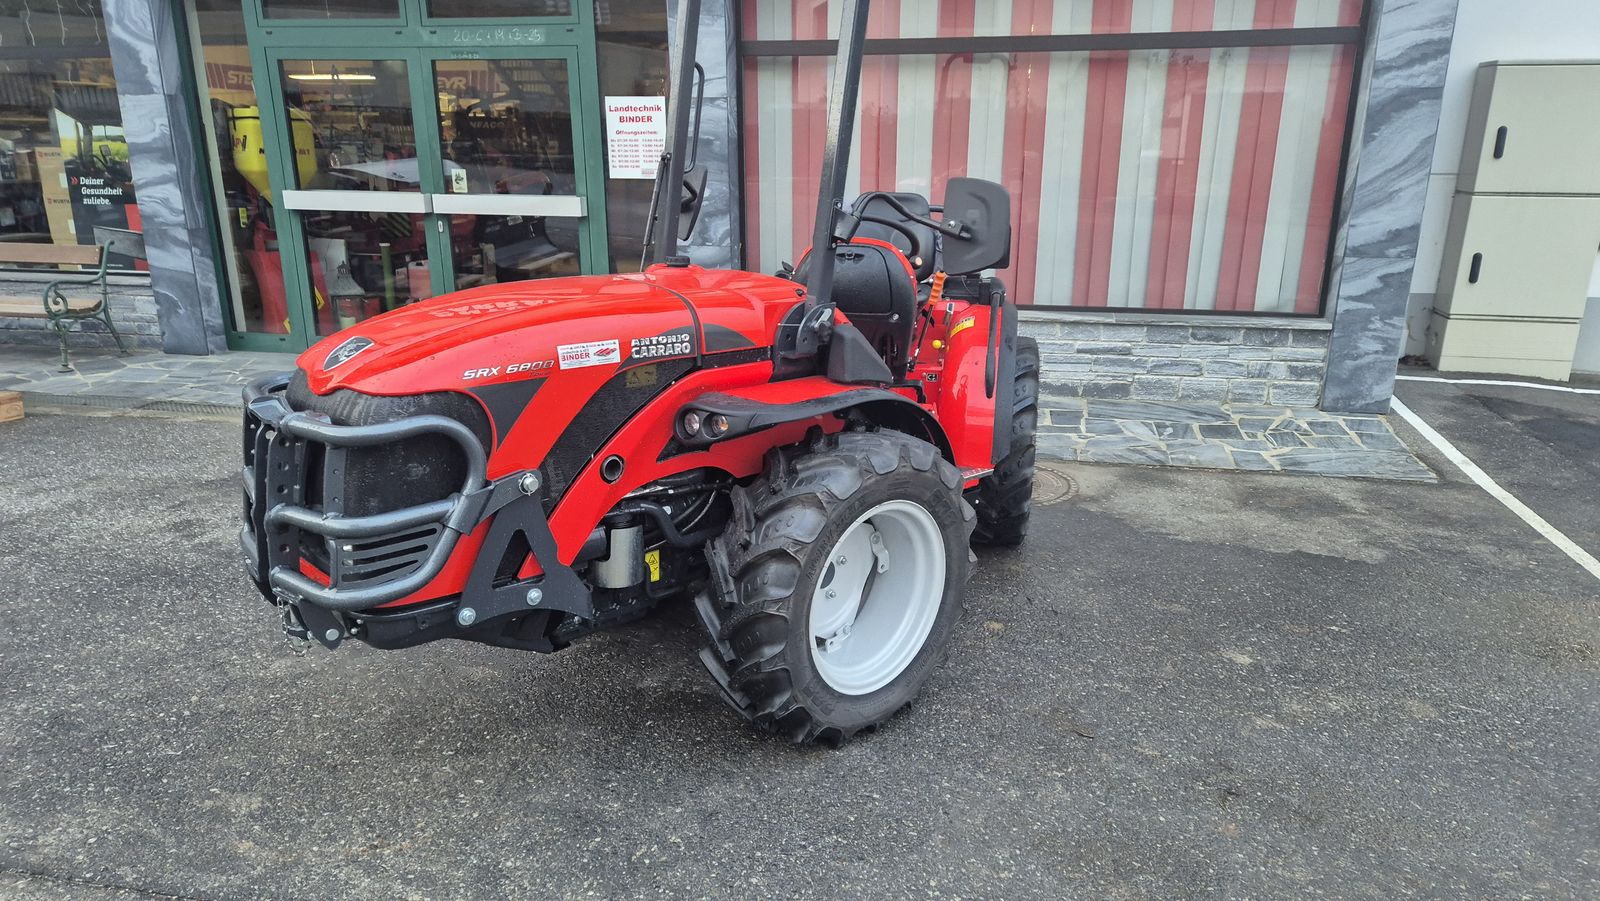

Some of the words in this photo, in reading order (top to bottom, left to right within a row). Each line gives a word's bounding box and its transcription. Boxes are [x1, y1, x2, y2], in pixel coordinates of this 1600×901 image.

[619, 115, 653, 123] BINDER
[79, 176, 104, 185] Deiner
[81, 187, 123, 196] Gesundheit
[83, 197, 112, 205] zuliebe.
[631, 333, 690, 346] ANTONIO
[631, 342, 691, 358] CARRARO
[561, 352, 591, 361] BINDER
[462, 366, 501, 380] SRX
[506, 360, 554, 374] 6800
